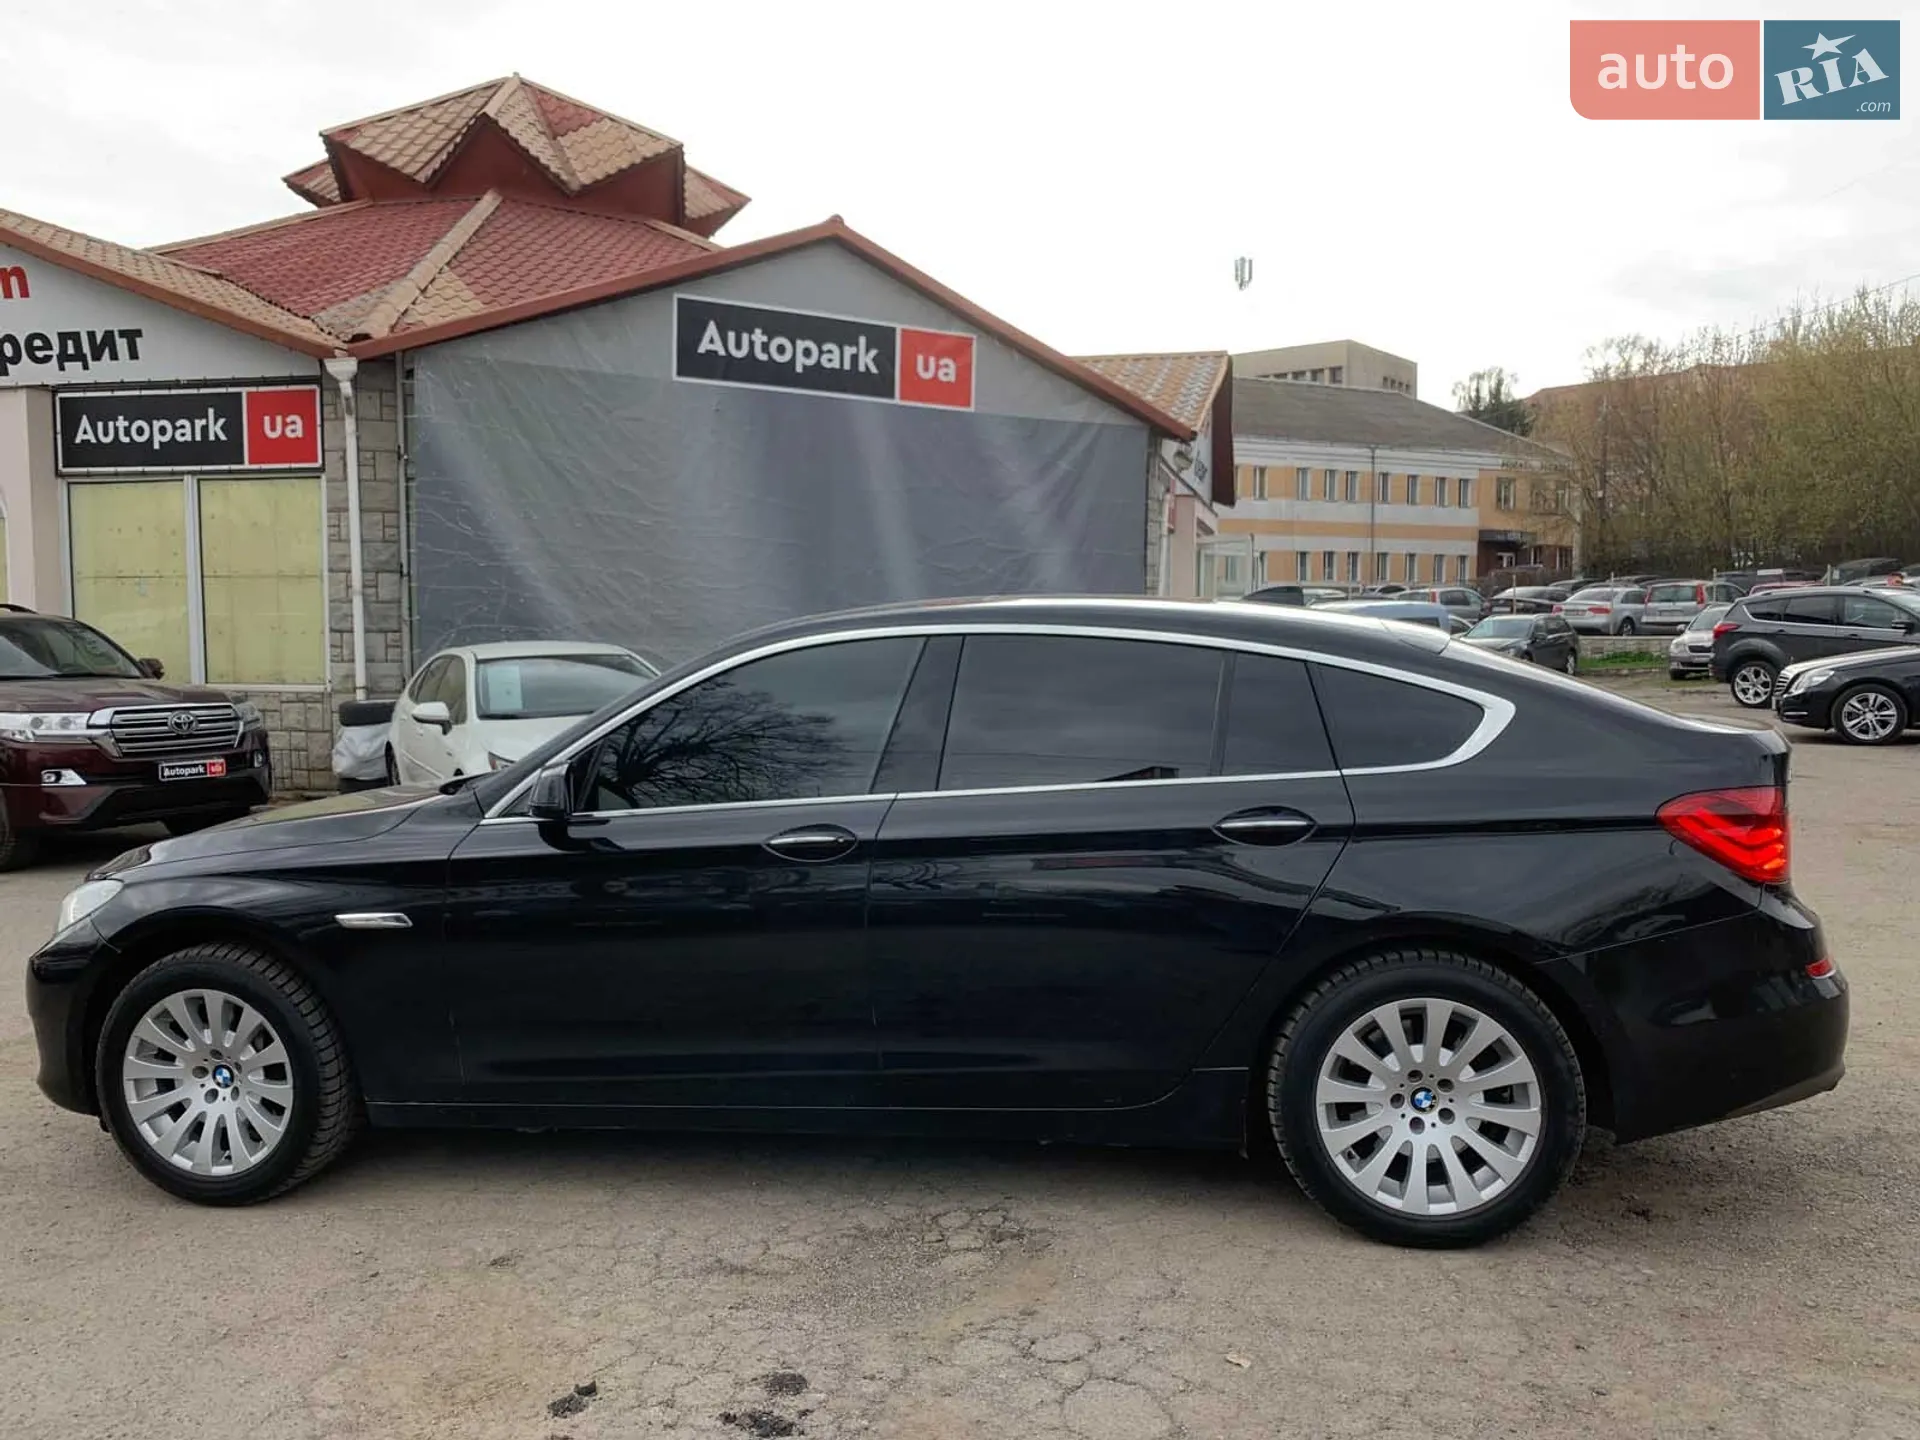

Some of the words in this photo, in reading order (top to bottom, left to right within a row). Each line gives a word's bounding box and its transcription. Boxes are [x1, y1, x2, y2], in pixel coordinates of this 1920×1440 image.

[697, 320, 879, 374] Autopark
[916, 354, 957, 383] ua
[74, 407, 228, 449] Autopark
[262, 413, 304, 438] ua
[164, 765, 205, 776] Autopark
